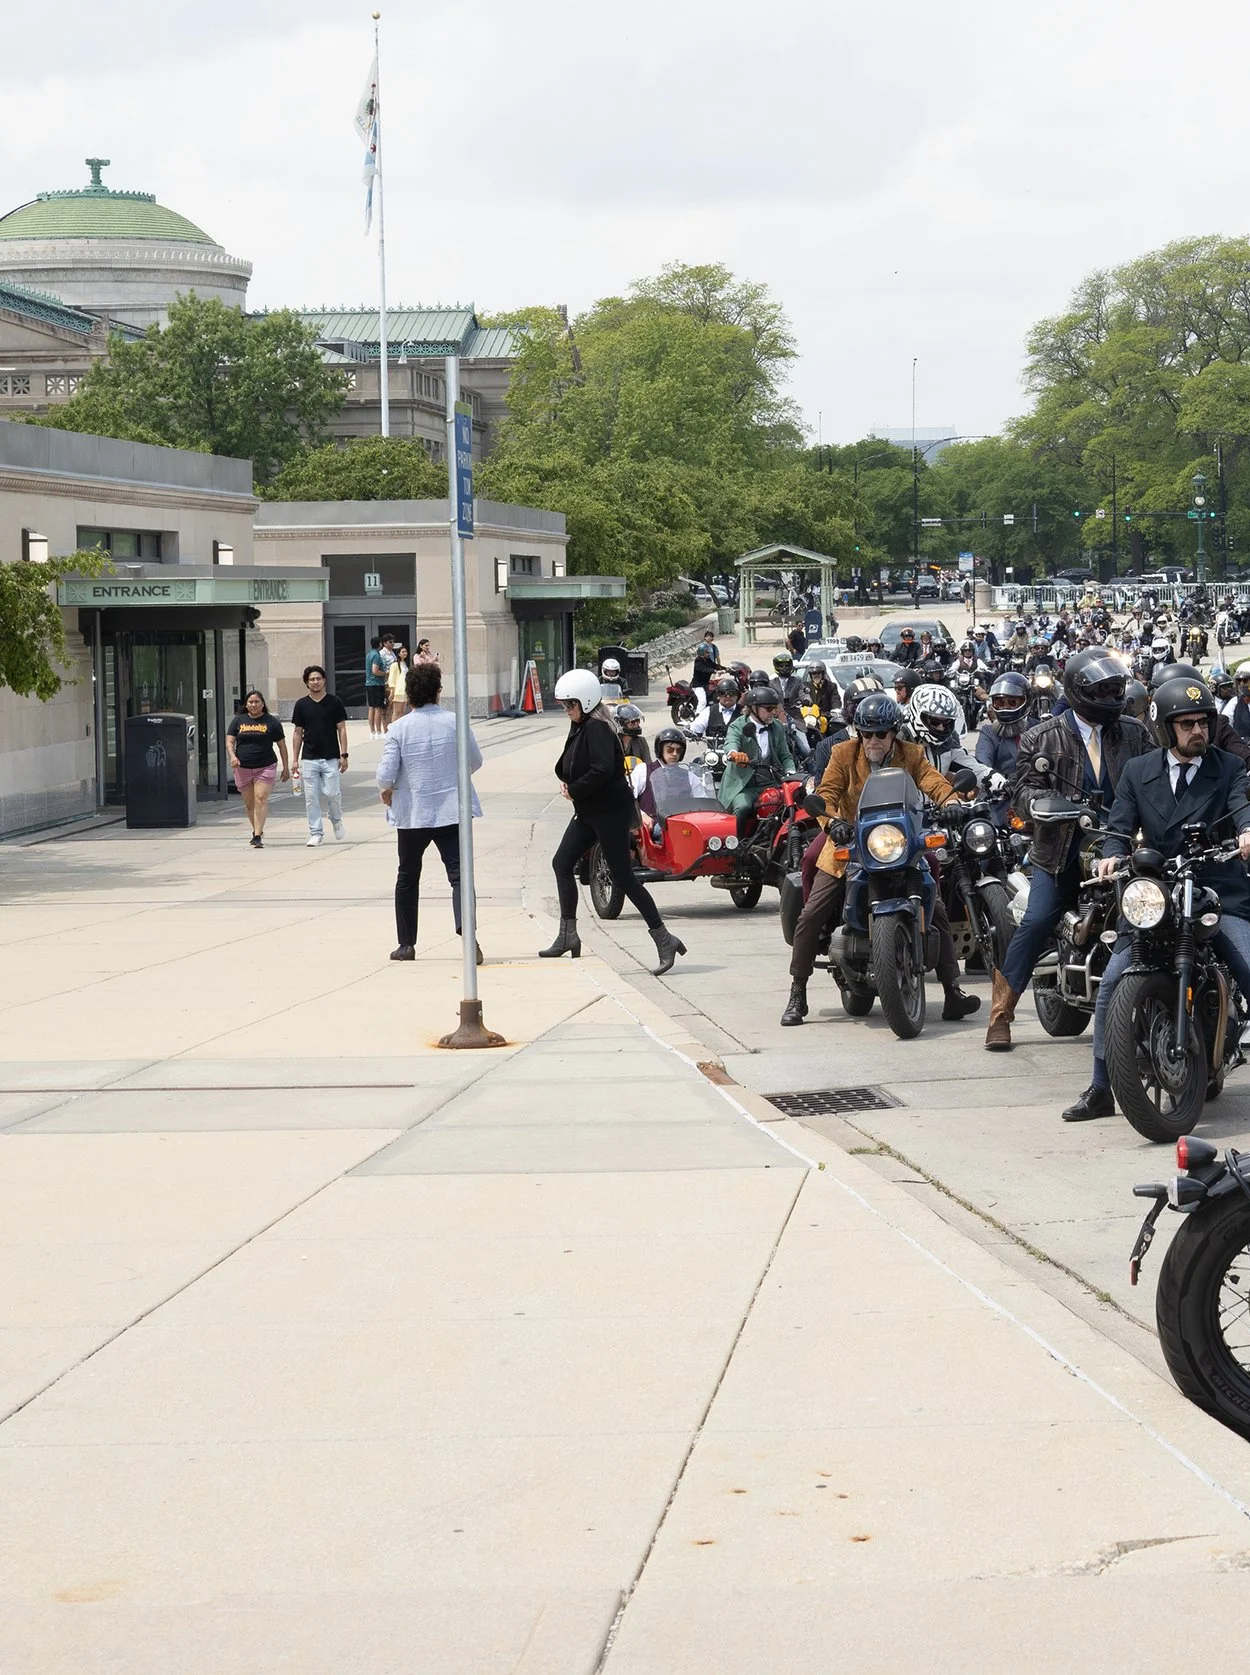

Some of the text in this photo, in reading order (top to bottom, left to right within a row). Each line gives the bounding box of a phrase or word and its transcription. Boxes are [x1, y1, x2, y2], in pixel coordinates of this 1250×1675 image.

[367, 575, 378, 587] 11
[93, 585, 171, 598] ENTRANCE
[253, 579, 287, 601] ENTRANCE
